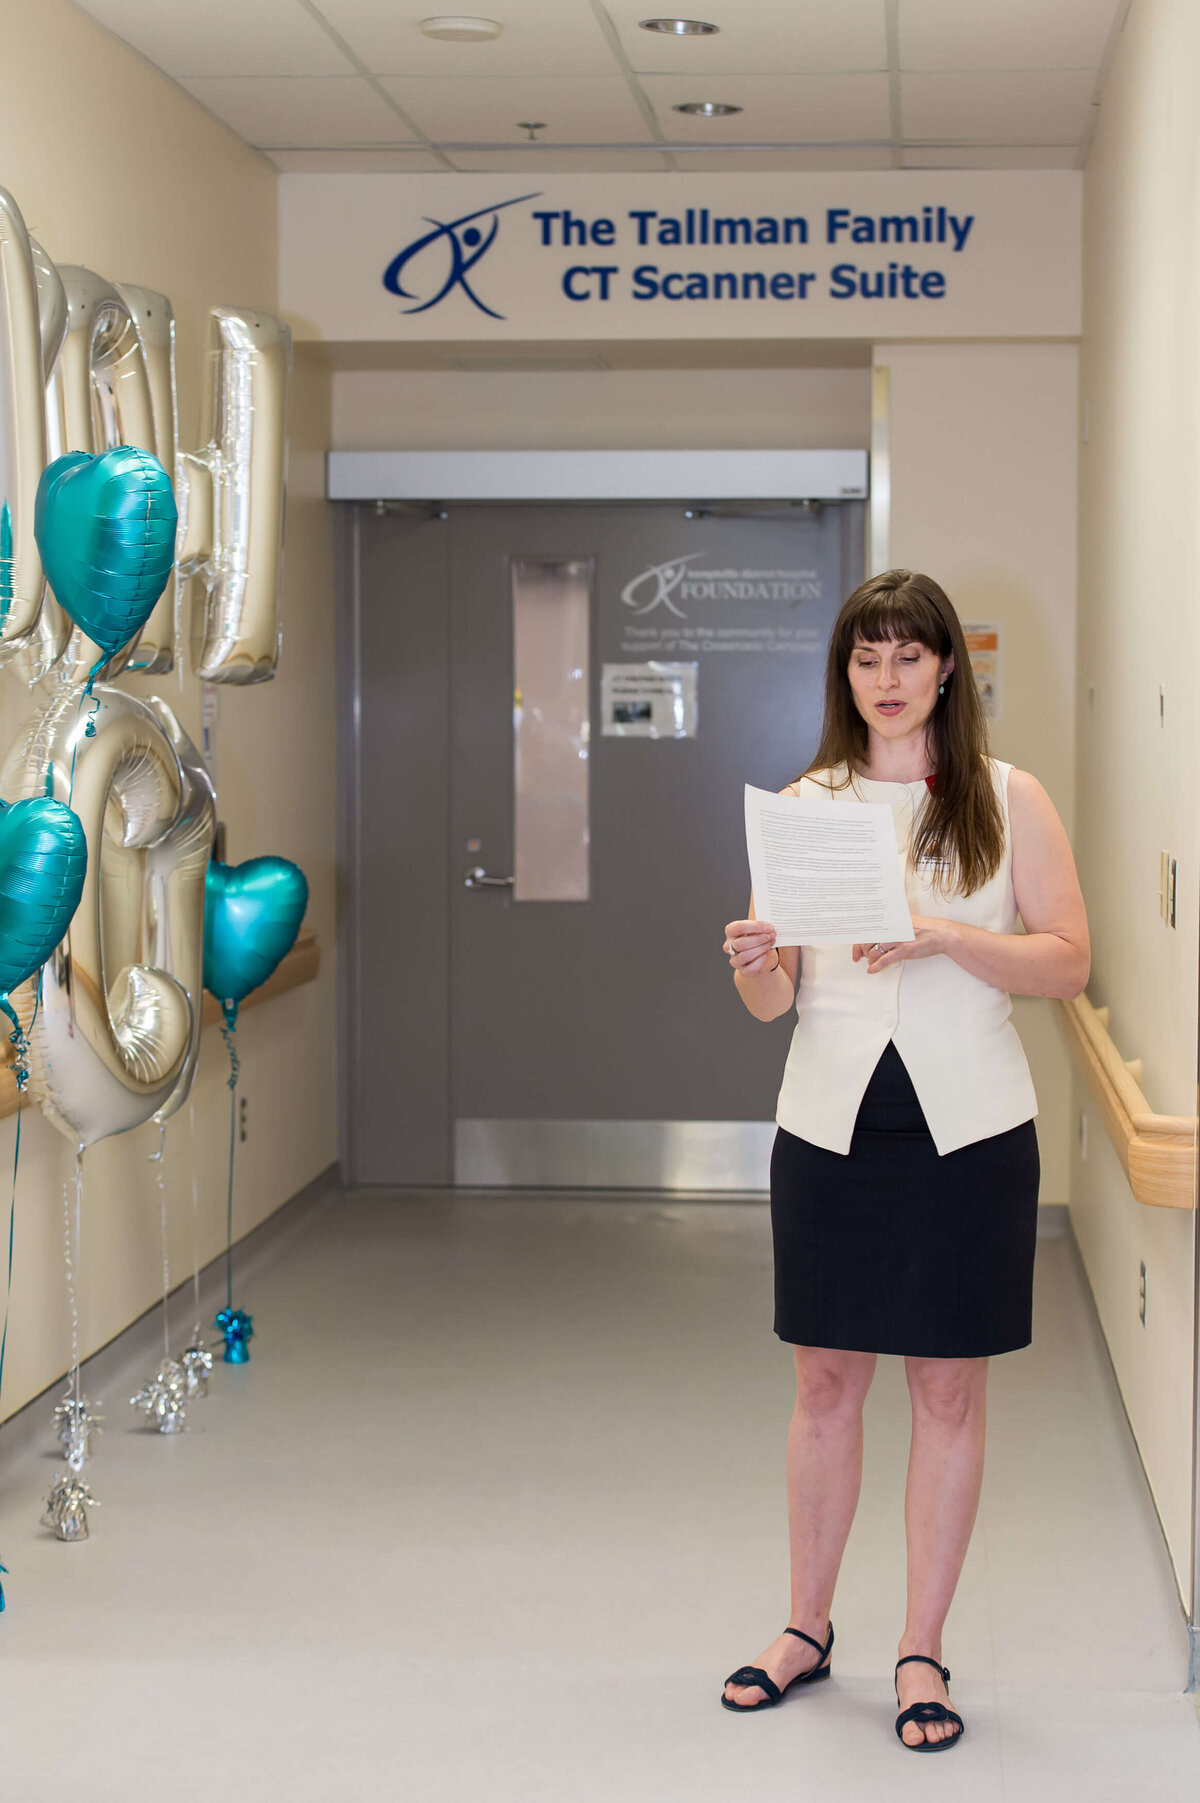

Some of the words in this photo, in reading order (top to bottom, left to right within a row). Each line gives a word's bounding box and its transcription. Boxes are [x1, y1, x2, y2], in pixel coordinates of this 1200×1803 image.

[532, 210, 615, 246] The
[629, 208, 808, 245] Tallman
[827, 206, 974, 252] Family
[562, 265, 619, 301] CT
[632, 264, 816, 300] Scanner
[829, 262, 946, 300] Suite
[680, 581, 822, 600] FOUNDATION
